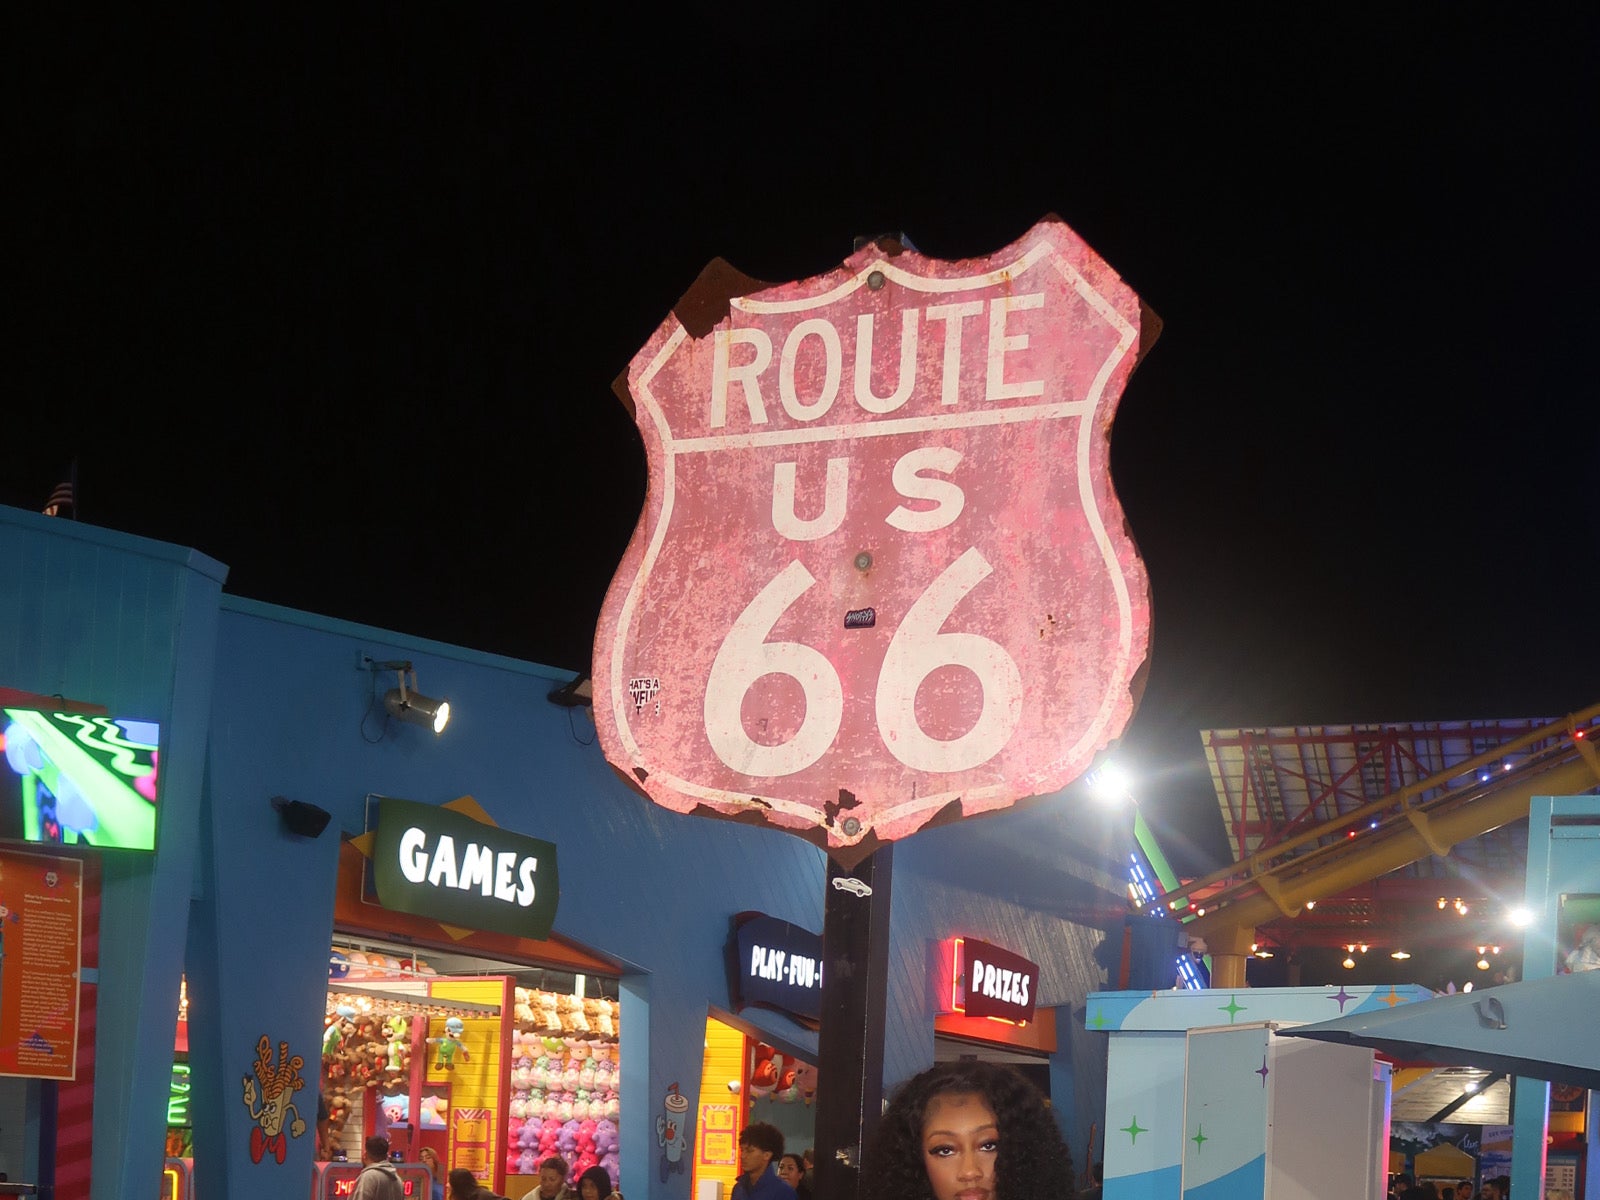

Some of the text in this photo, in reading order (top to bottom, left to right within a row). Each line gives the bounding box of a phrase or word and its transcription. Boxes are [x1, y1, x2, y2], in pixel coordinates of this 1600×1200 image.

[710, 293, 1045, 428] ROUTE
[703, 546, 1021, 777] 66
[399, 827, 538, 907] GAMES
[972, 959, 1030, 1007] PRIZES
